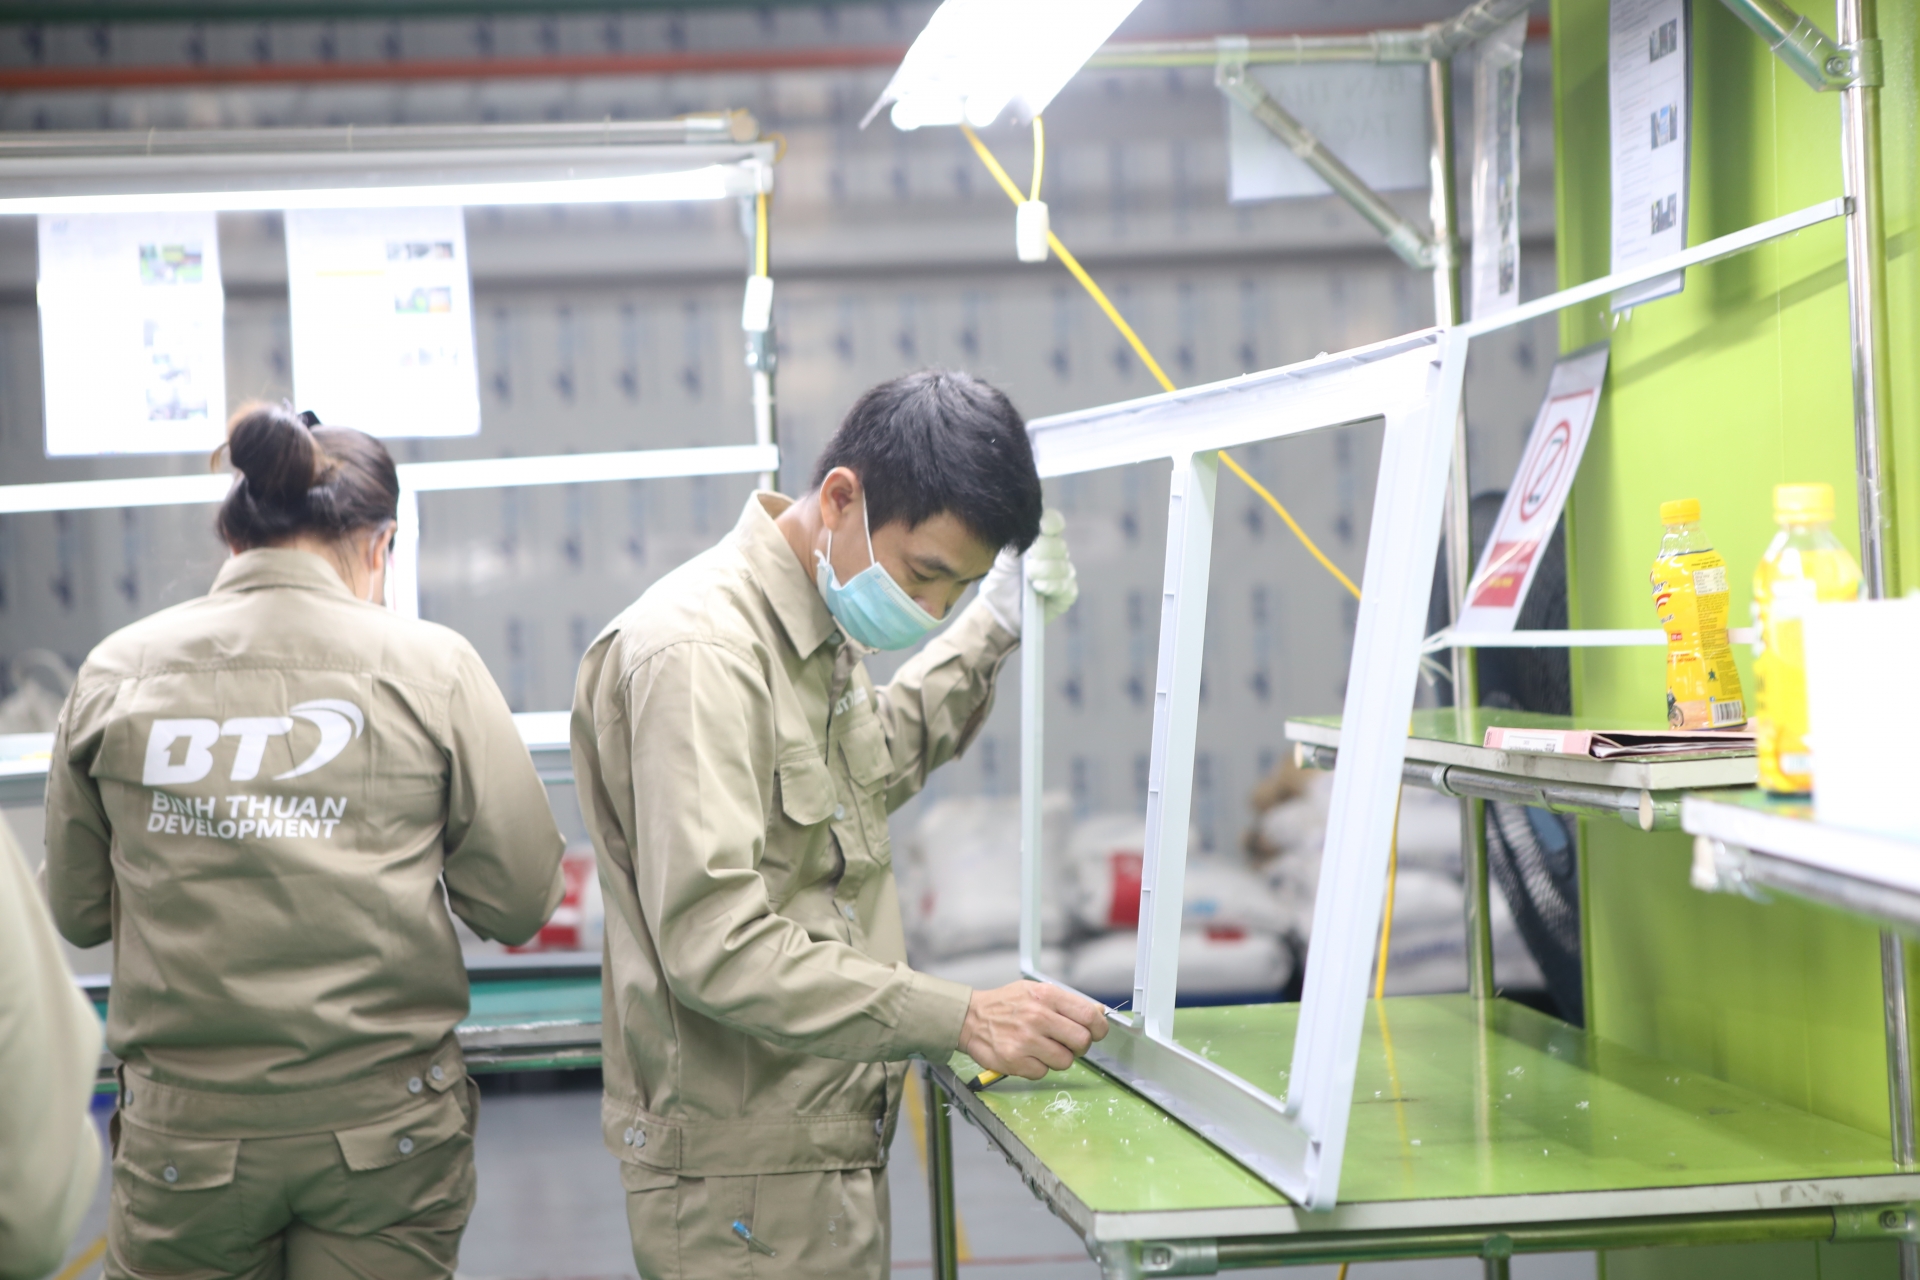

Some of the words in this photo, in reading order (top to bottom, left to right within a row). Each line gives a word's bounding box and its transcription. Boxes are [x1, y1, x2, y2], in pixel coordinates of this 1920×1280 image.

[152, 791, 216, 819] BINH
[225, 795, 347, 819] THUAN
[147, 813, 340, 839] DEVELOPMENT
